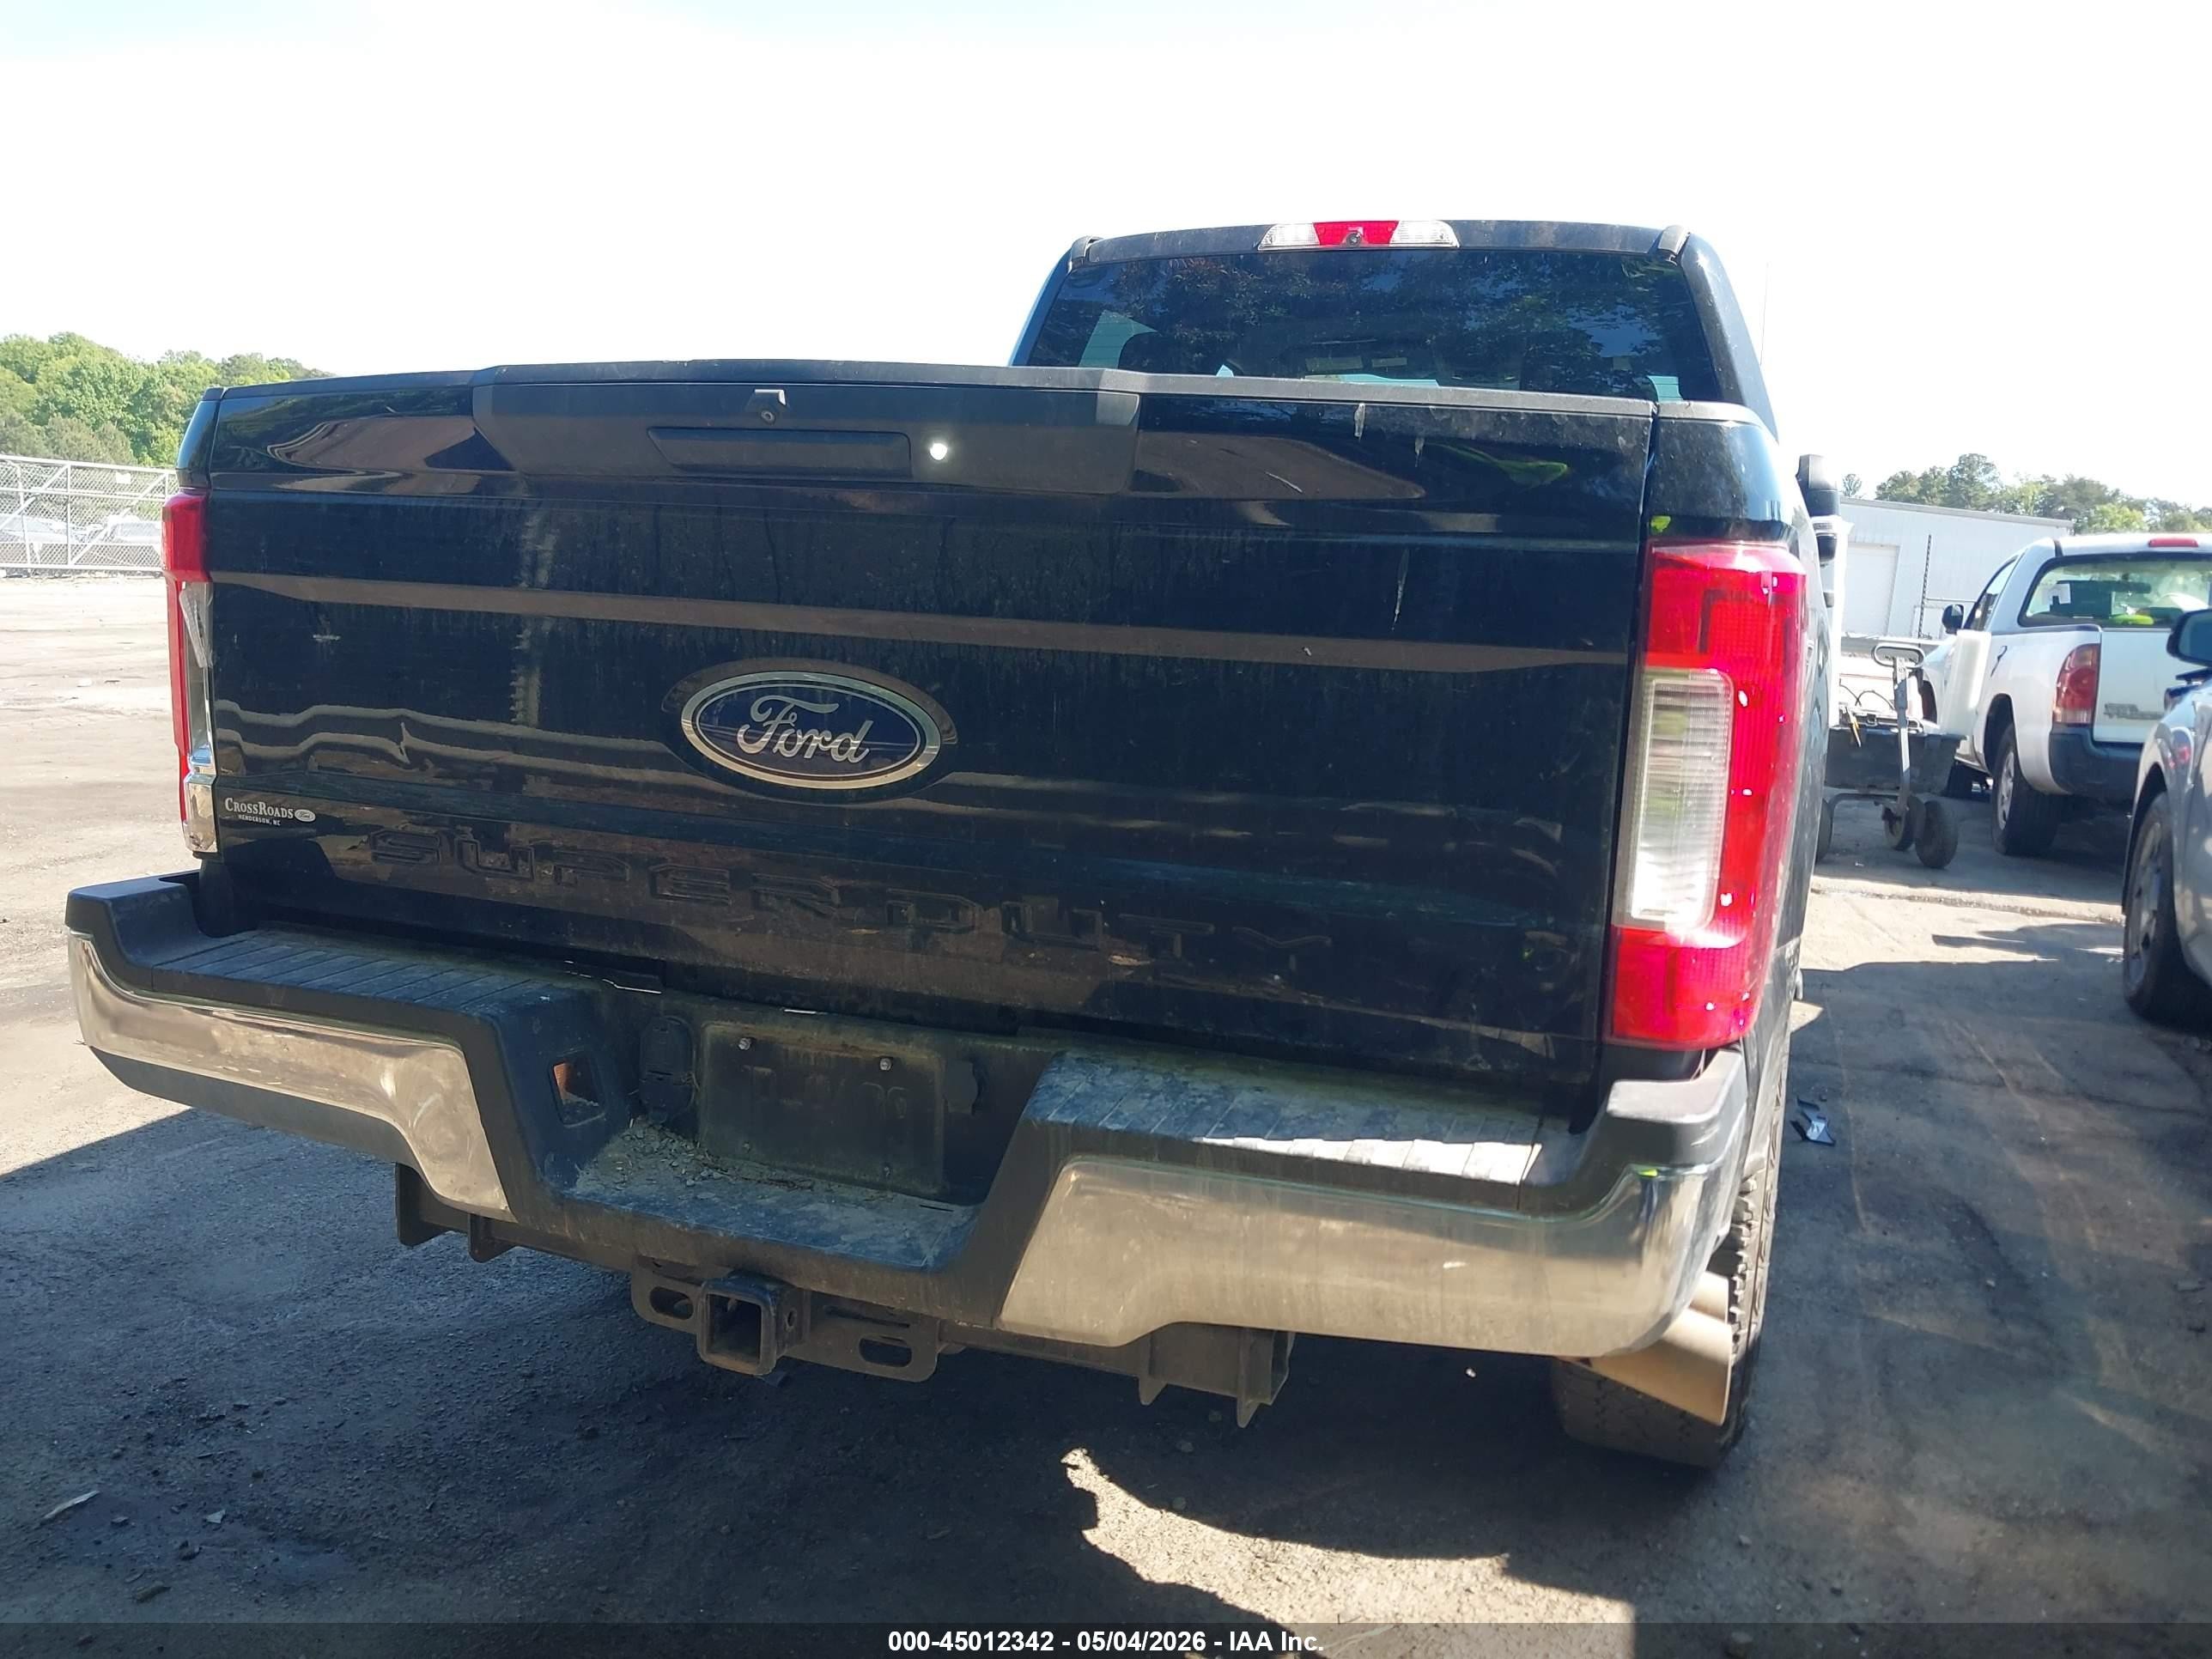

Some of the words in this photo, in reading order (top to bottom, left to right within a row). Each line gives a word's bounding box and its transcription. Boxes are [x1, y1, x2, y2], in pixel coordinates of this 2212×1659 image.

[737, 695, 873, 763] Ford
[238, 814, 272, 825] HENDERSON,
[369, 827, 841, 920] SUPER
